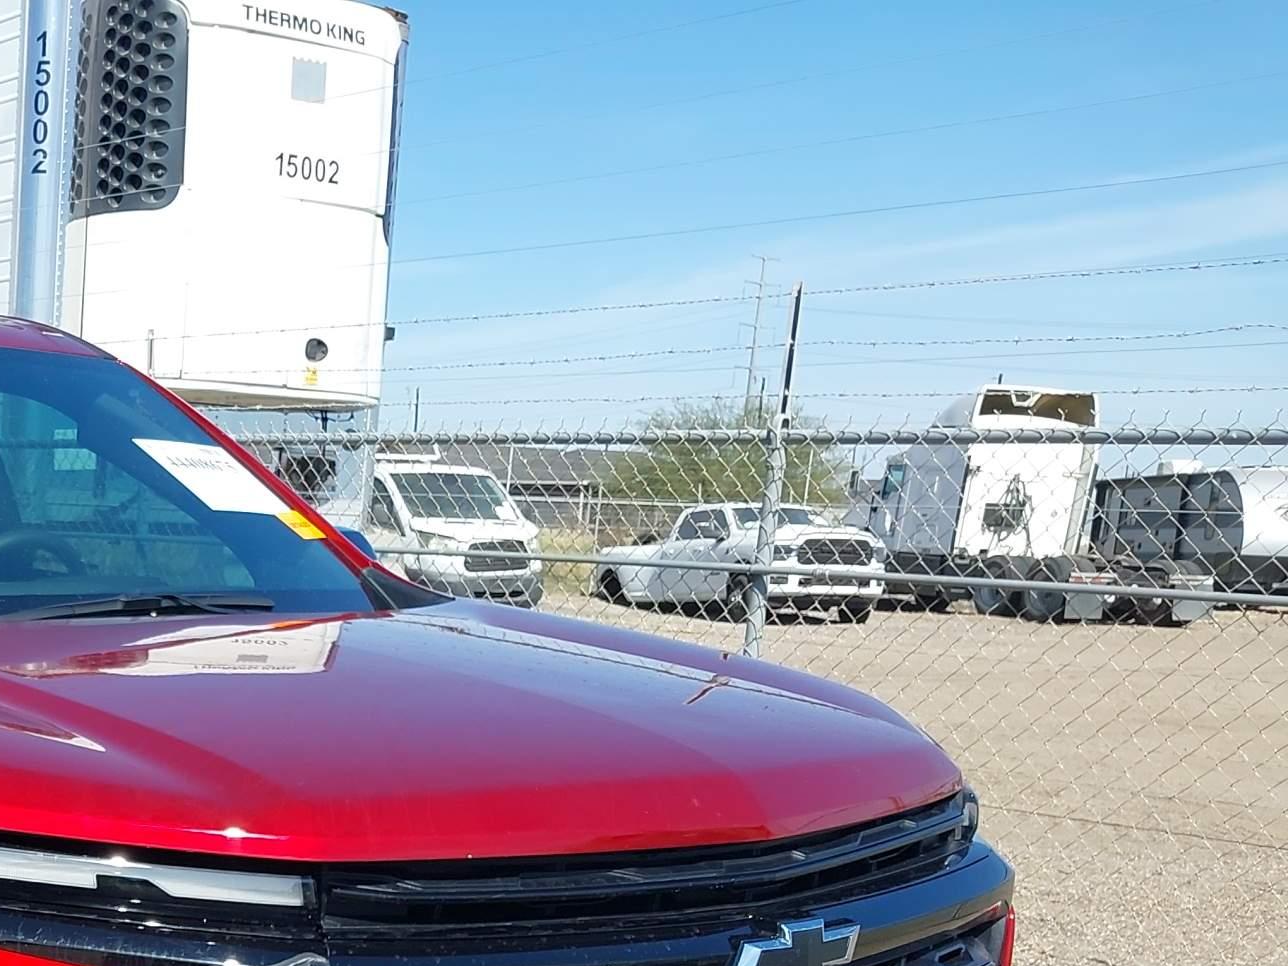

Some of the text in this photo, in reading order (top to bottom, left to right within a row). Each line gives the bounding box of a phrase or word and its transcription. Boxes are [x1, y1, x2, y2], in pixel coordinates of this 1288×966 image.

[243, 4, 366, 46] THERMO KING
[29, 30, 52, 175] 15002
[275, 152, 340, 185] 15002
